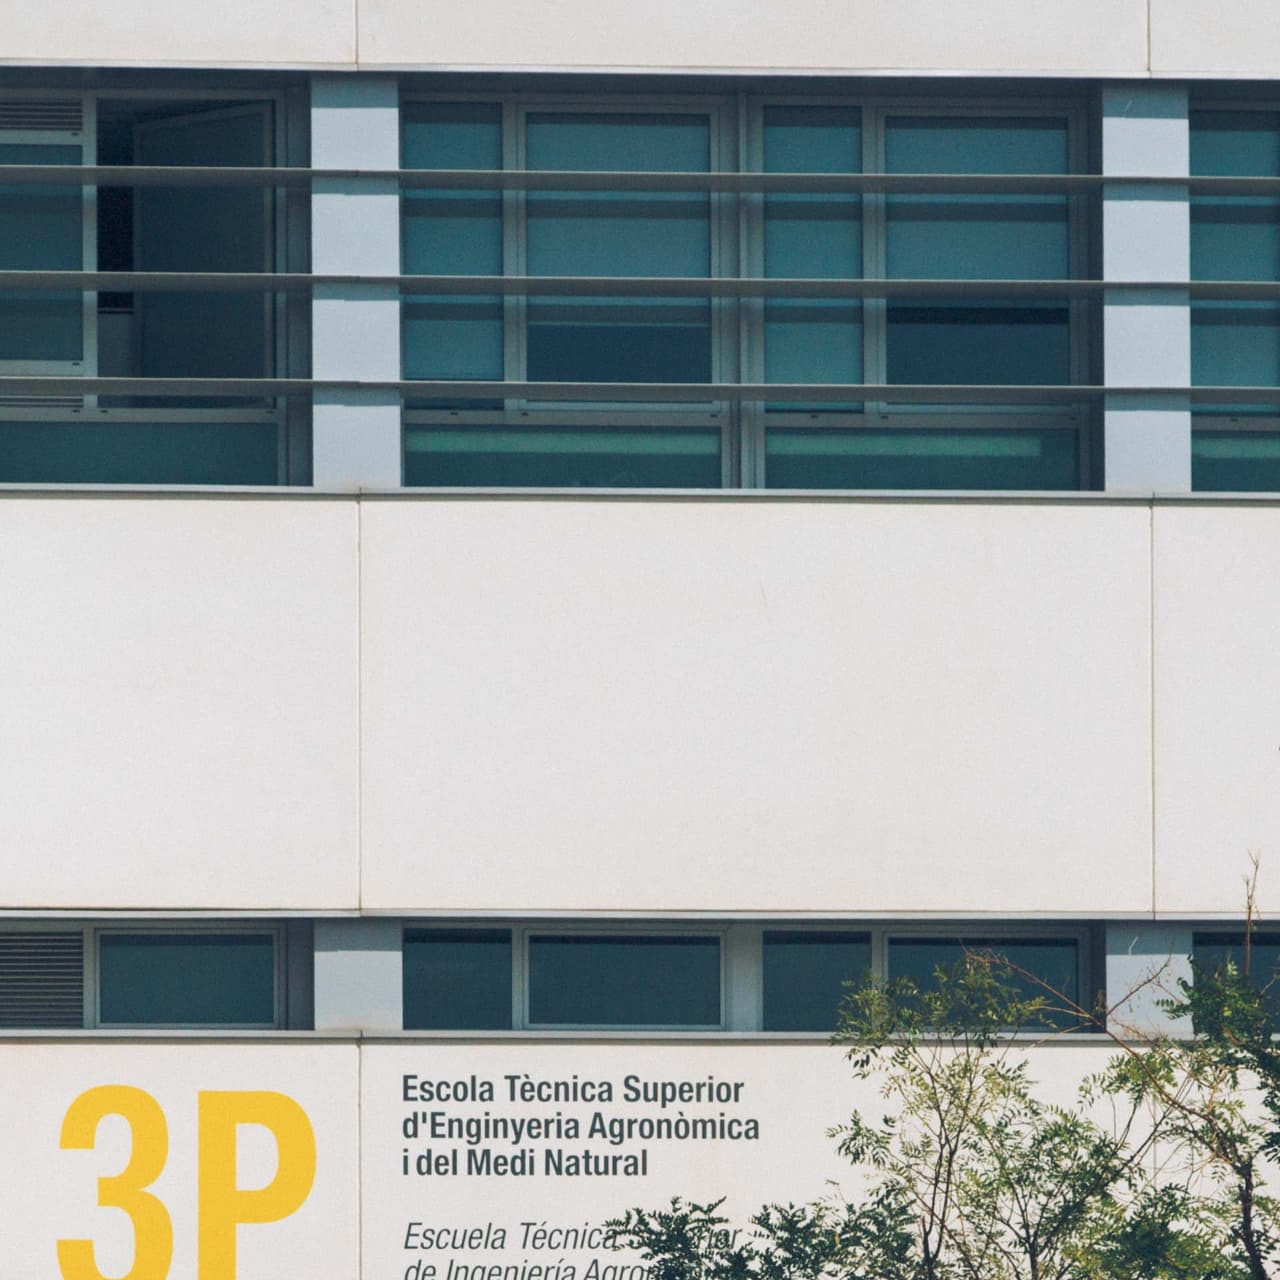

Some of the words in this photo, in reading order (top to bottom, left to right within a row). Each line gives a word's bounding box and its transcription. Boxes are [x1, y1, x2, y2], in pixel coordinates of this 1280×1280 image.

[402, 1074, 494, 1102] Escola
[504, 1074, 613, 1102] Tècnica
[623, 1074, 745, 1109] Superior
[402, 1111, 580, 1146] d'Enginyeria
[588, 1111, 760, 1146] Agronòmica
[402, 1148, 409, 1176] i
[416, 1148, 458, 1176] del
[467, 1148, 535, 1176] Medi
[544, 1148, 648, 1177] Natural
[403, 1222, 507, 1250] Escuela
[520, 1221, 618, 1250] Técnica
